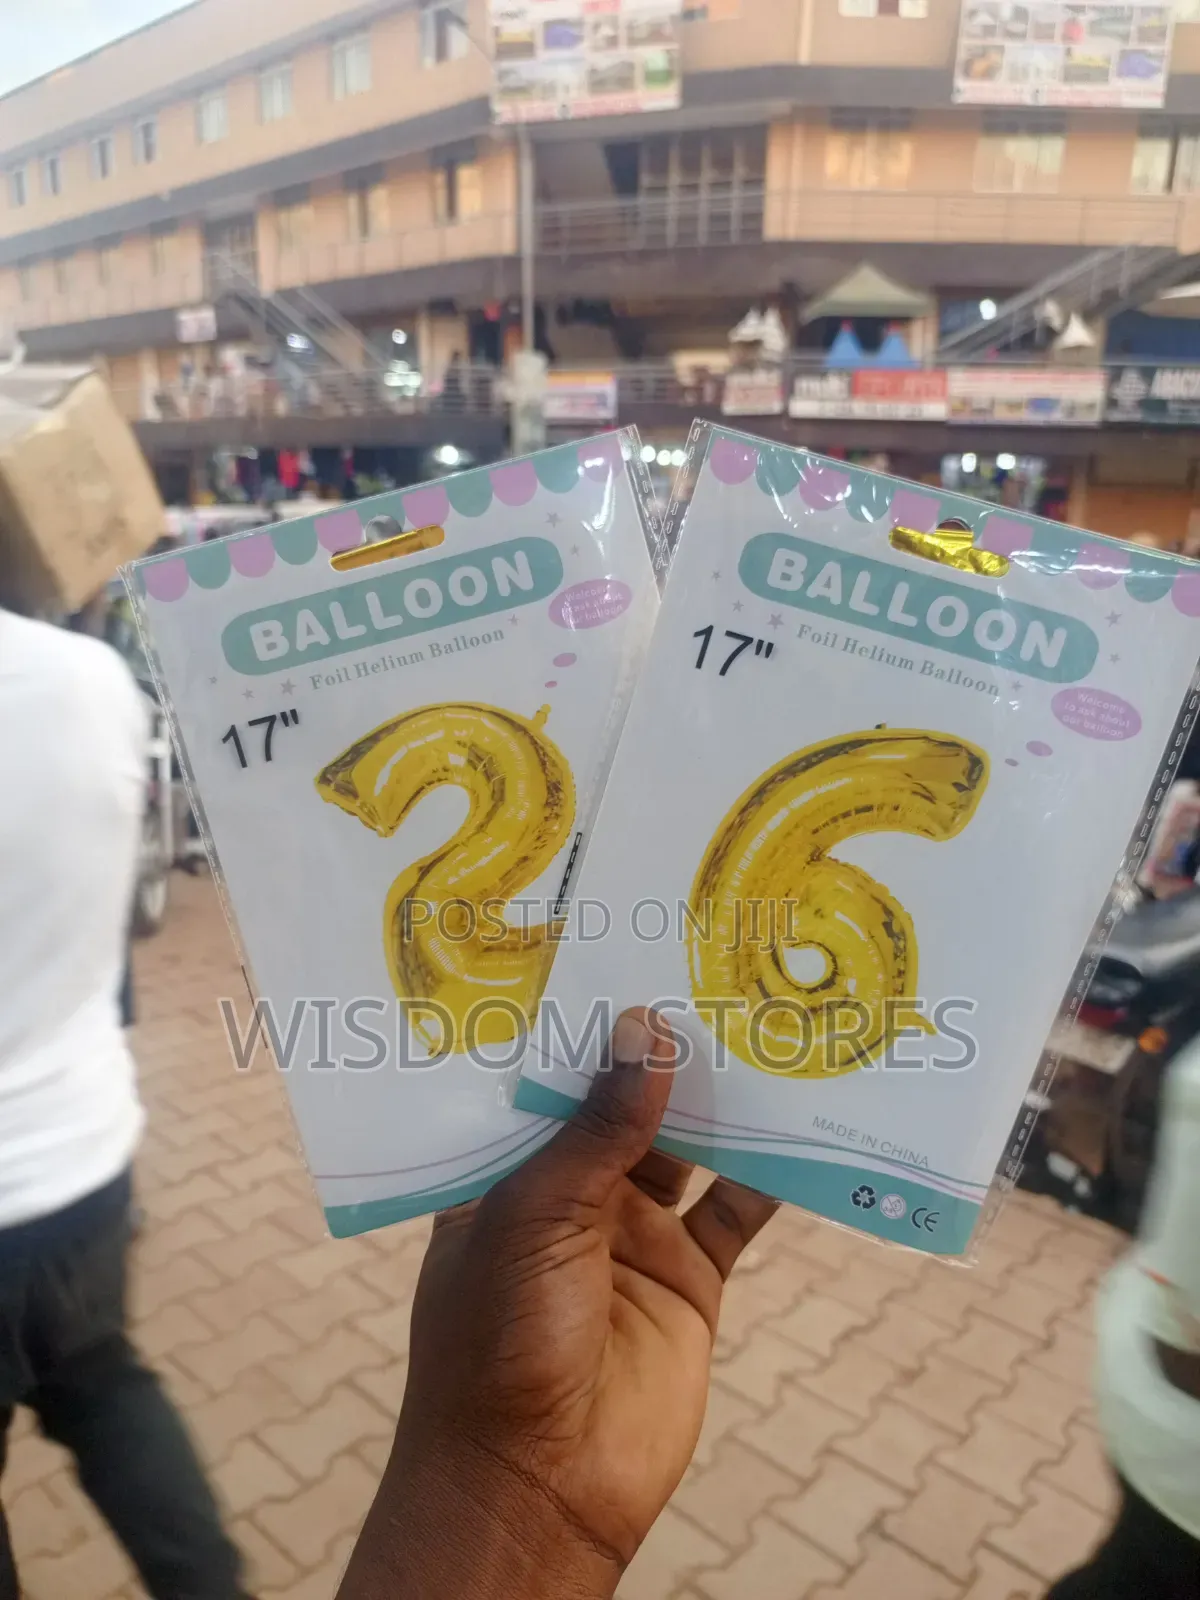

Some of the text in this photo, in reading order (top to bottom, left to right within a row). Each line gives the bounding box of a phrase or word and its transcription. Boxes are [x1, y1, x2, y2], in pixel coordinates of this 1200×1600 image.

[249, 549, 536, 662] BALLOON
[766, 547, 1068, 669] BALLOON
[309, 628, 505, 691] Foil Helium Balloon
[692, 624, 776, 677] 17"
[796, 623, 1000, 697] Foil Helium Balloon
[1077, 692, 1126, 714] Welcome
[221, 708, 300, 769] 17"
[812, 1116, 929, 1168] MADE IN CHINA
